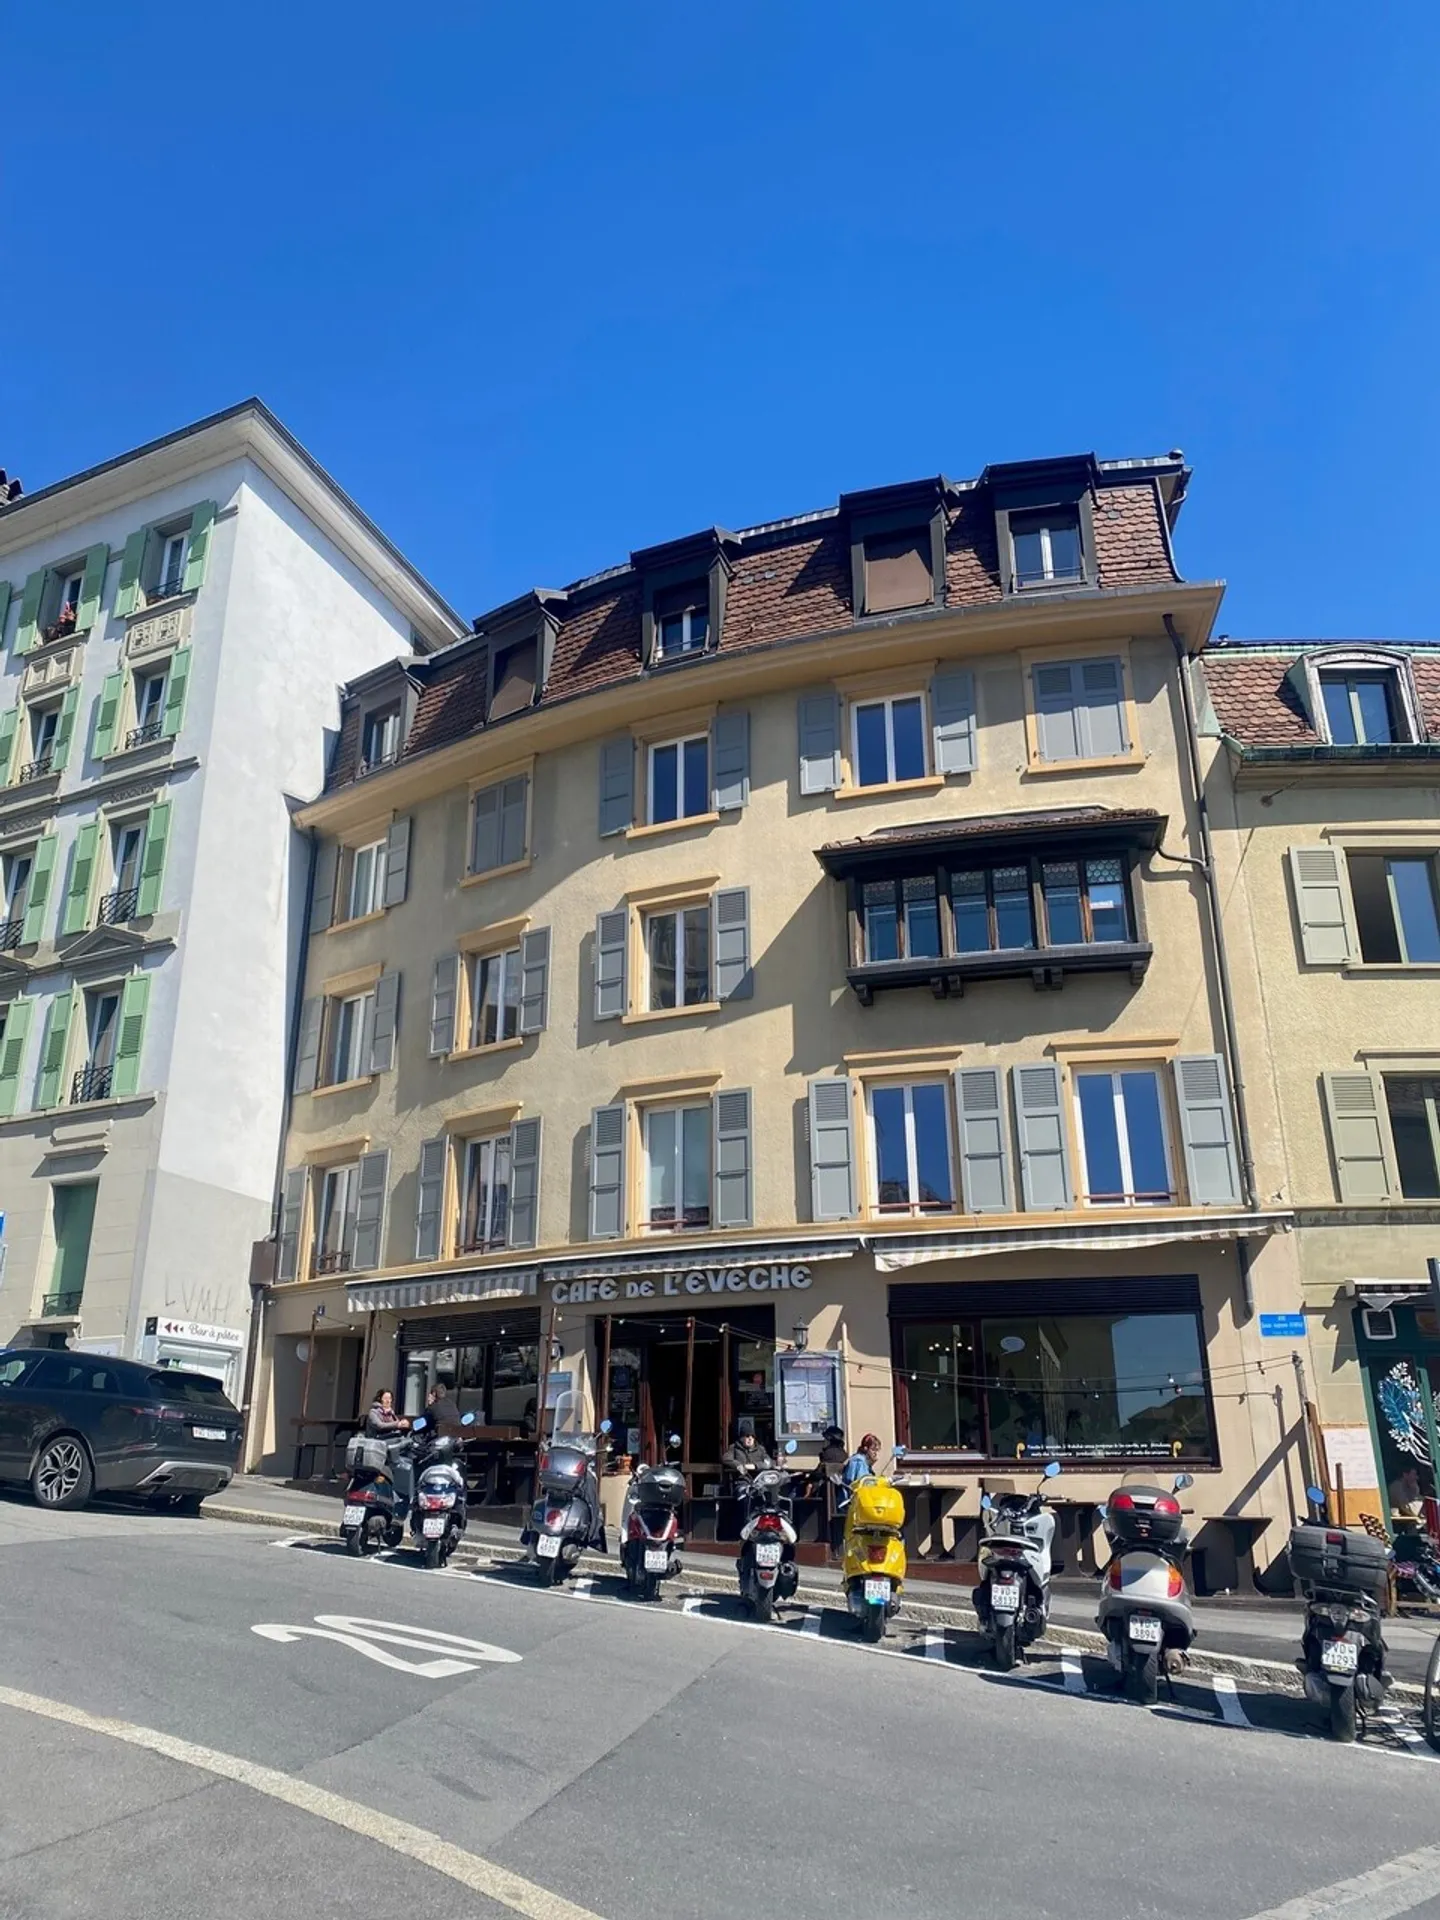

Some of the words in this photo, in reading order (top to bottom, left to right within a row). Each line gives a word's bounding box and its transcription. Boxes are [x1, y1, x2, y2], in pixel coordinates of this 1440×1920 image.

[165, 1271, 232, 1323] LVMH
[551, 1277, 619, 1304] CAFE
[663, 1265, 813, 1296] L'EVECHE
[188, 1323, 207, 1336] Bar
[208, 1327, 216, 1338] à
[251, 1615, 523, 1679] 20
[1325, 1653, 1355, 1667] 71293
